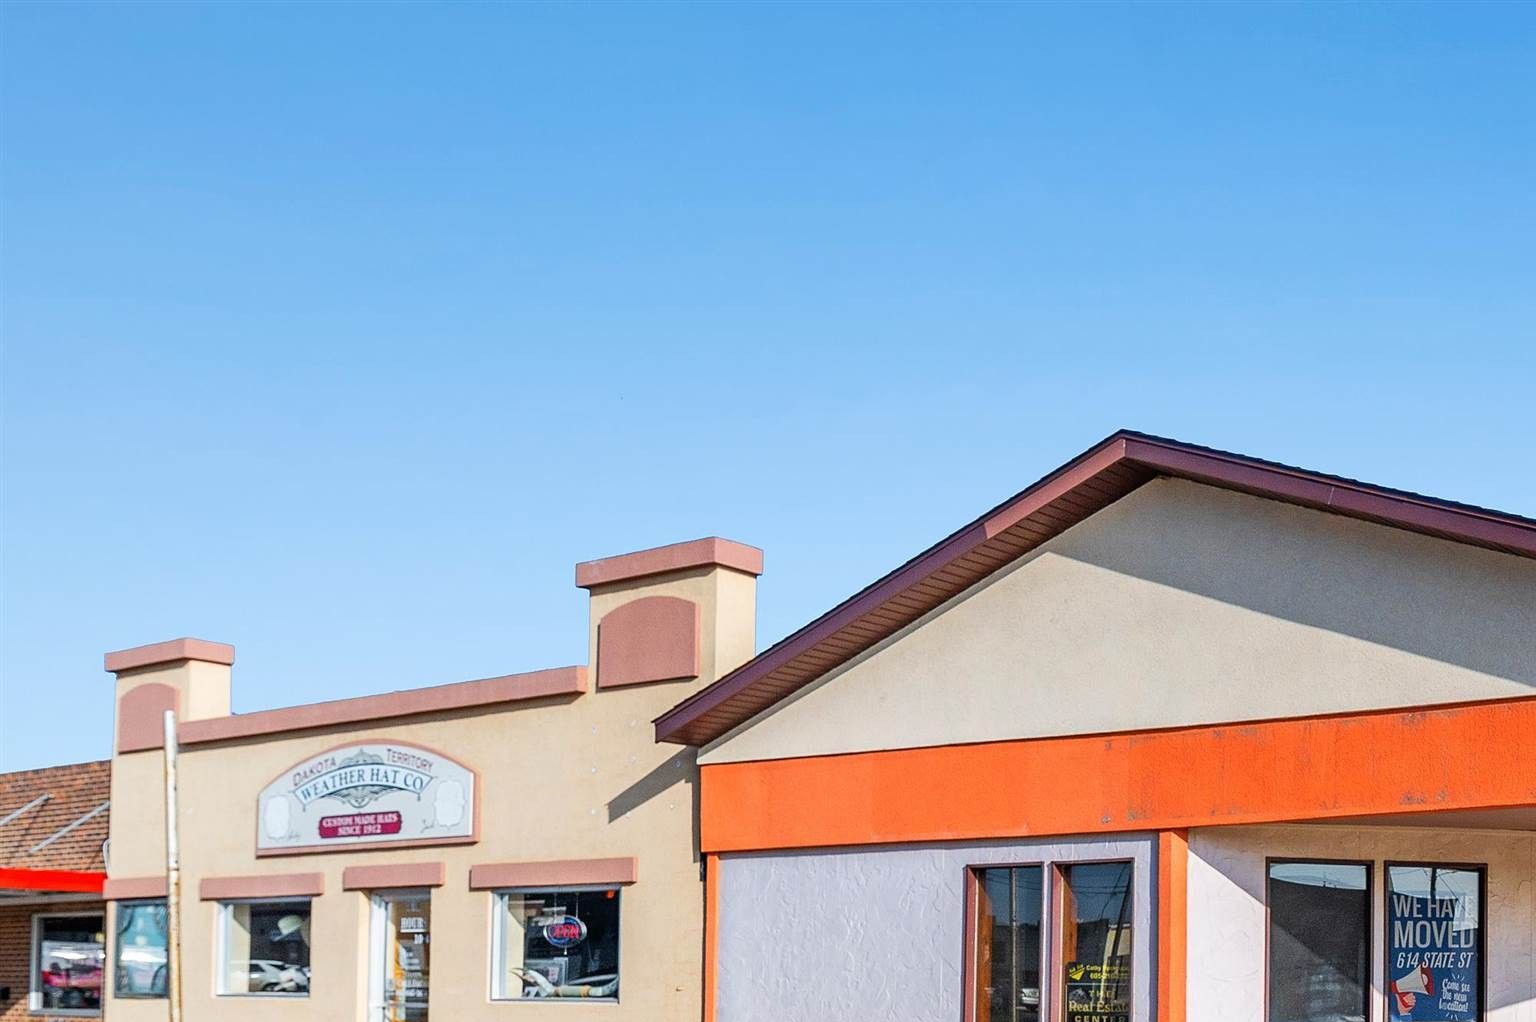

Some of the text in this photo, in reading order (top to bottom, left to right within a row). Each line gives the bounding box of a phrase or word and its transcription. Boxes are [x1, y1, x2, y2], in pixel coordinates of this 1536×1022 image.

[292, 748, 434, 787] DAKOTA TERRITORY
[370, 767, 399, 784] HAT
[1392, 895, 1423, 918] WE
[1394, 920, 1474, 949] MOVED
[1396, 951, 1474, 968] 614 STATE ST
[1068, 1000, 1093, 1013] Real
